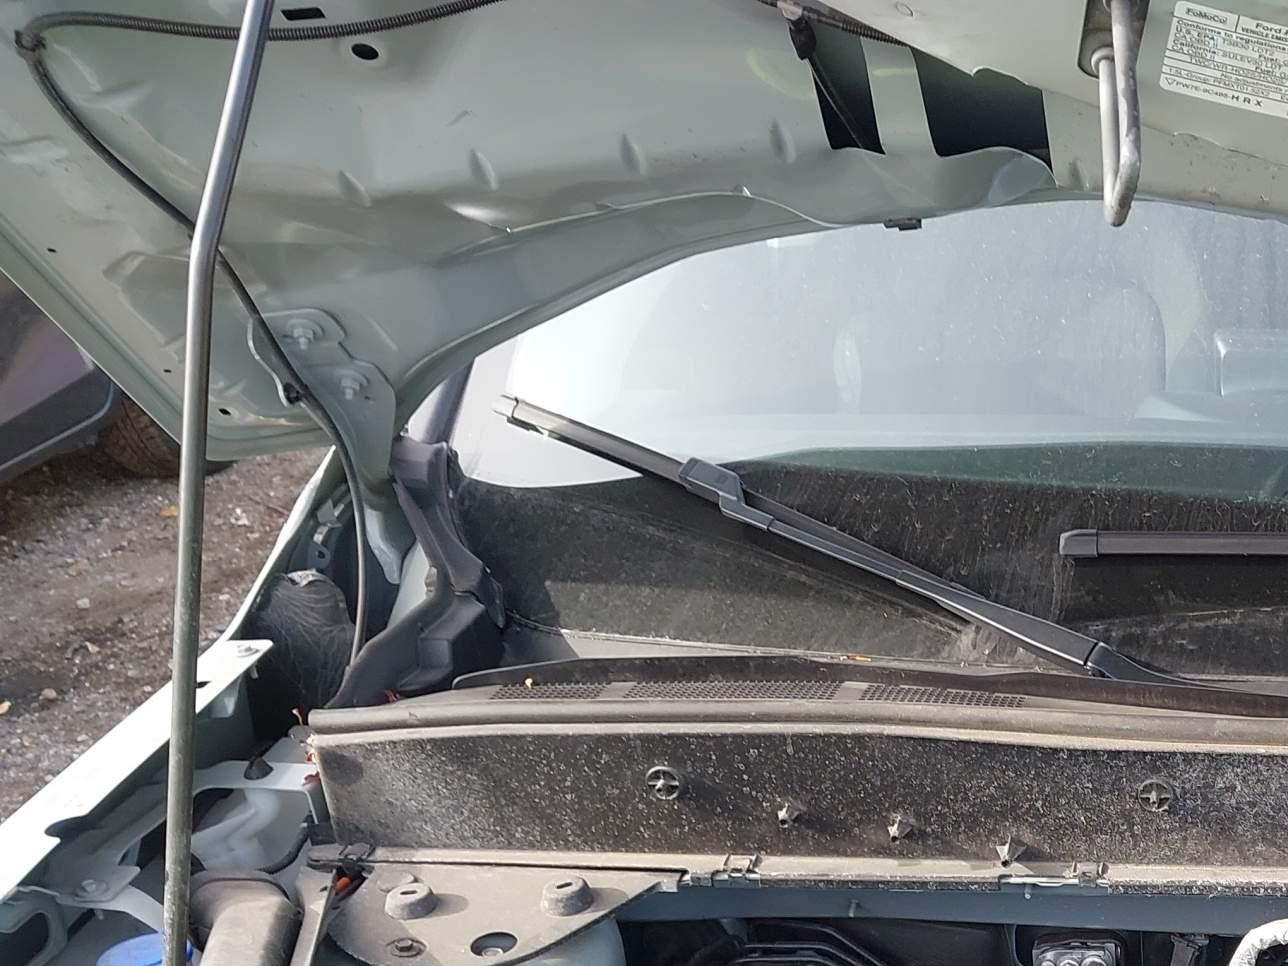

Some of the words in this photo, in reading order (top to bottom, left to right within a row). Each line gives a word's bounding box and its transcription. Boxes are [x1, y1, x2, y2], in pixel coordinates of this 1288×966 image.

[1184, 8, 1227, 25] FoMoCo
[1176, 20, 1222, 36] Conforms
[1241, 26, 1269, 39] VEHICLE
[1255, 22, 1282, 34] Ford
